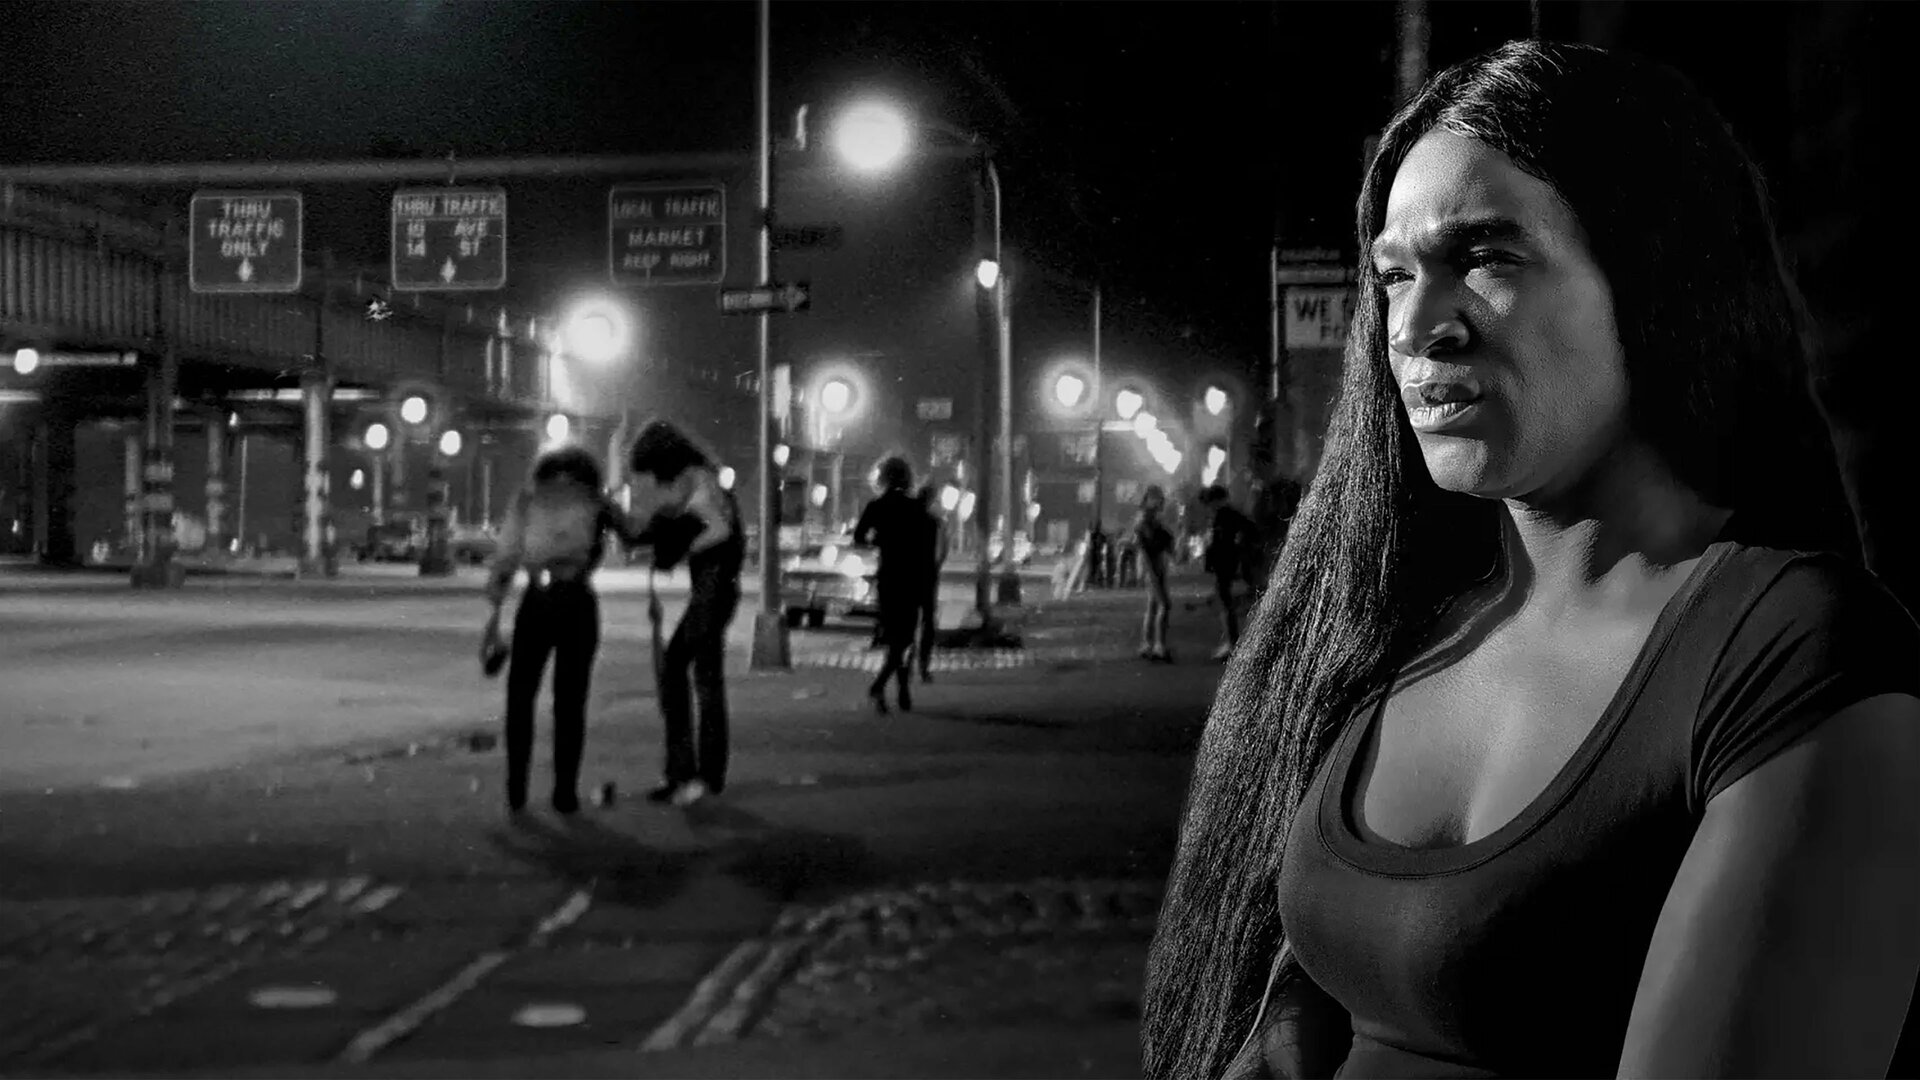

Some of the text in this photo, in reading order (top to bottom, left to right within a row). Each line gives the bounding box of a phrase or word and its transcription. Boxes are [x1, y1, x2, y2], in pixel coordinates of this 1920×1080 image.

[222, 202, 271, 219] THRU
[663, 197, 721, 217] TRAFFIC
[208, 219, 284, 238] TRAFFIC
[454, 219, 488, 238] AVE
[628, 228, 704, 247] MARKET
[221, 240, 269, 257] ONLY
[459, 240, 480, 256] ST
[623, 251, 710, 269] KEEP RIGHT
